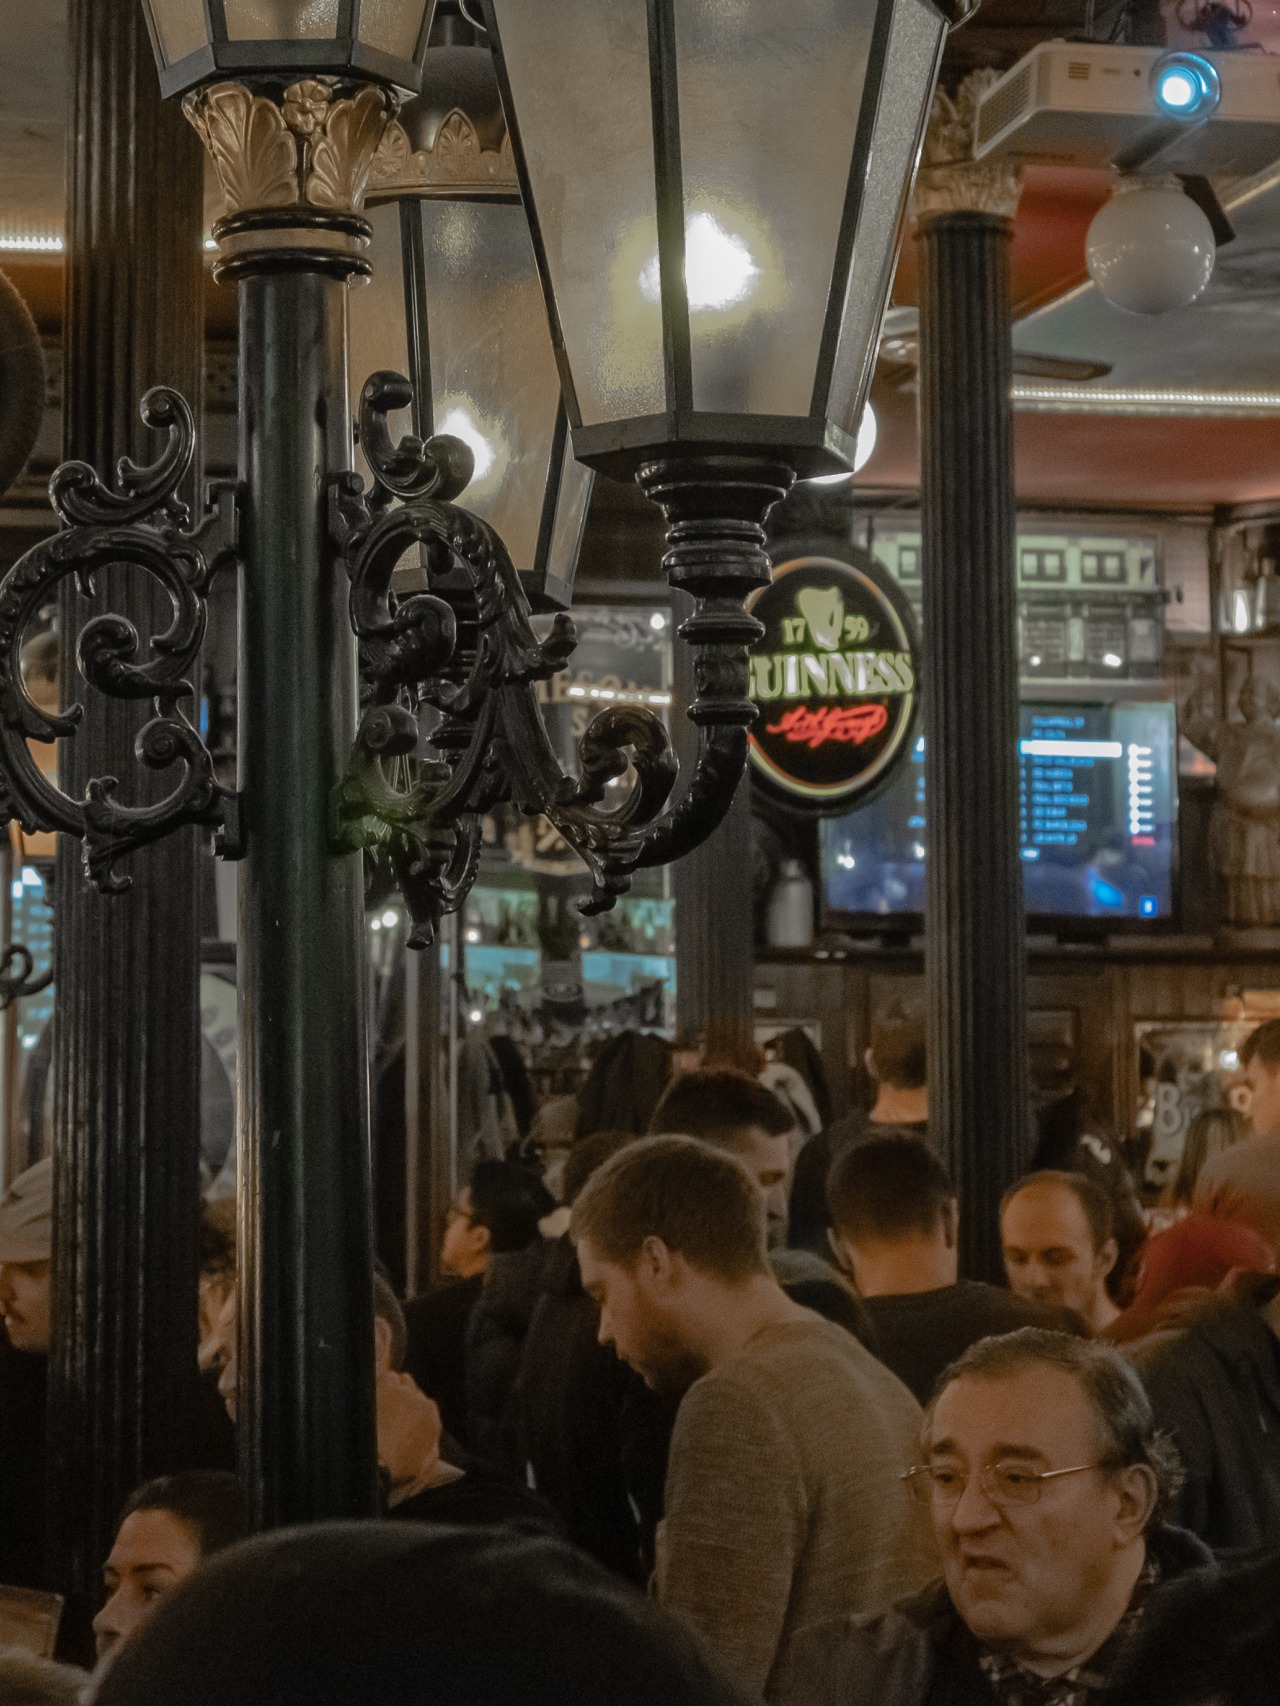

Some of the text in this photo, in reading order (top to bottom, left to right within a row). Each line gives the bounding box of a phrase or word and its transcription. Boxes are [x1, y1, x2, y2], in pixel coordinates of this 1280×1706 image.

[781, 615, 869, 645] 17 59
[749, 652, 914, 698] UINNESS
